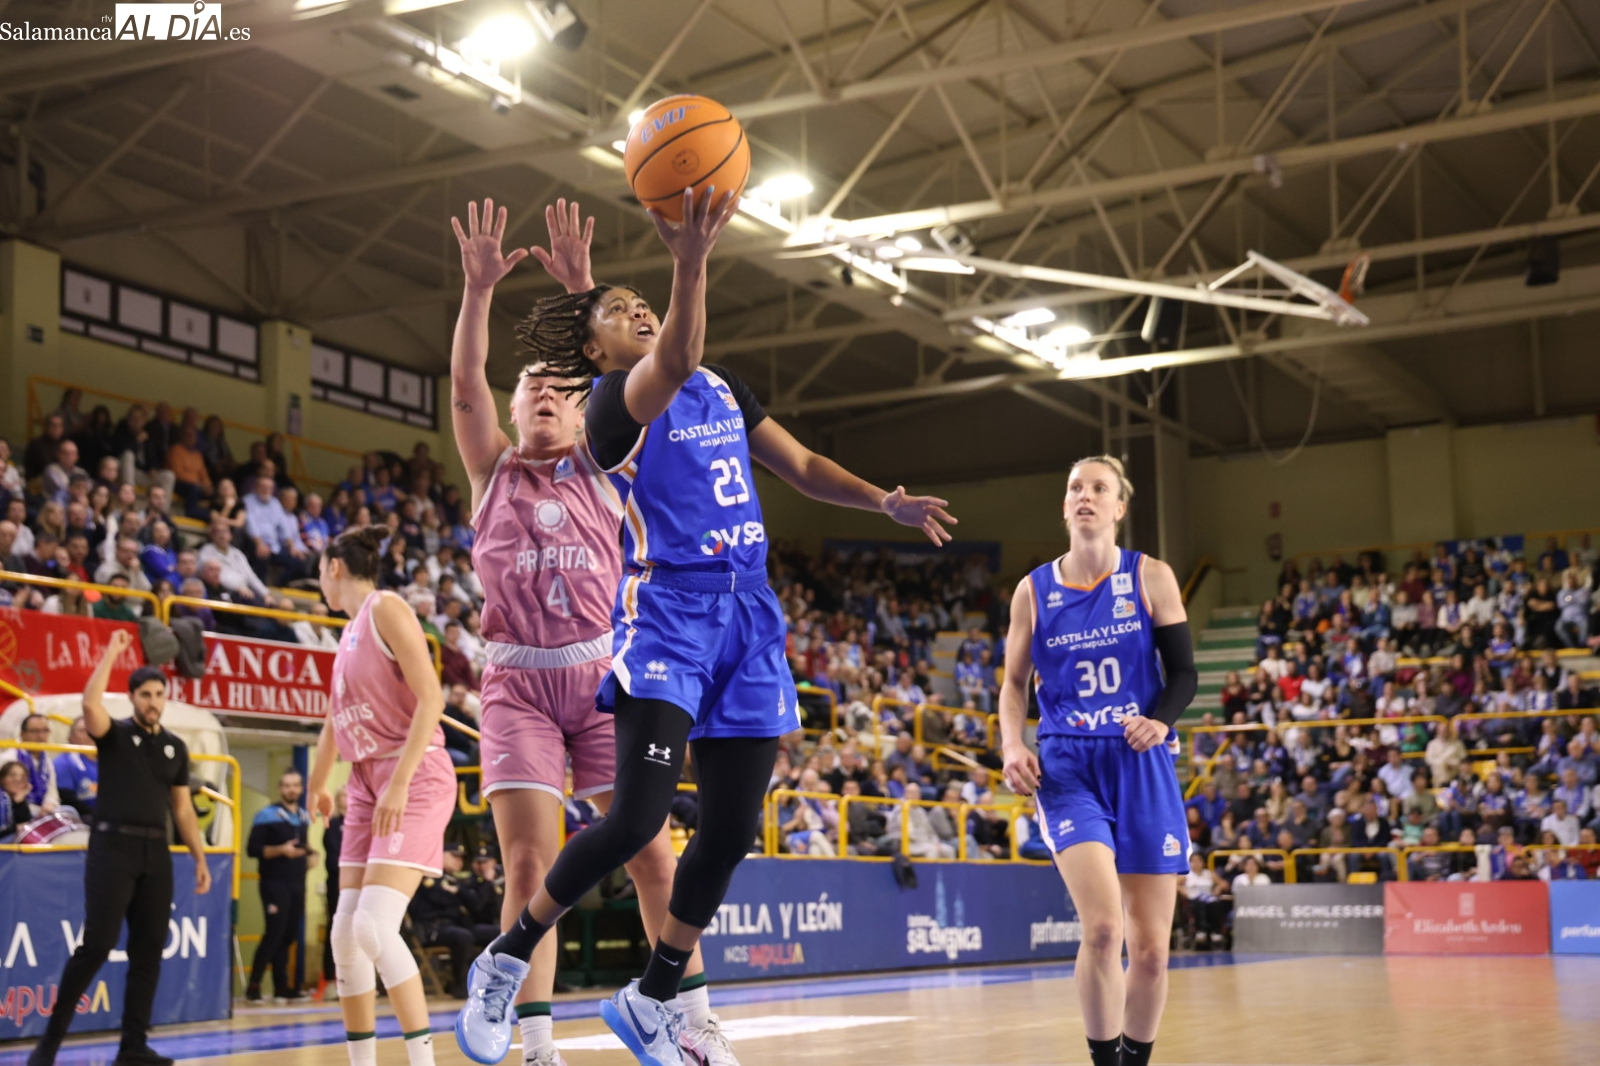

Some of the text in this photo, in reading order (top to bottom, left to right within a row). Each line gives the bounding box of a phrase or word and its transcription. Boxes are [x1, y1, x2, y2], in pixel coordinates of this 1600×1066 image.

[668, 421, 727, 443] CASTILLA
[722, 418, 733, 433] Y
[709, 456, 750, 508] 23
[546, 575, 572, 617] 4
[1046, 619, 1142, 648] CASTILLA Y LEÓN
[206, 641, 323, 687] ANCA
[1075, 656, 1122, 698] 30
[193, 677, 223, 708] LA
[227, 681, 329, 717] HUMANID
[702, 891, 843, 940] STILLA Y LEÓN
[1236, 904, 1385, 919] ANGEL SCHLESSER
